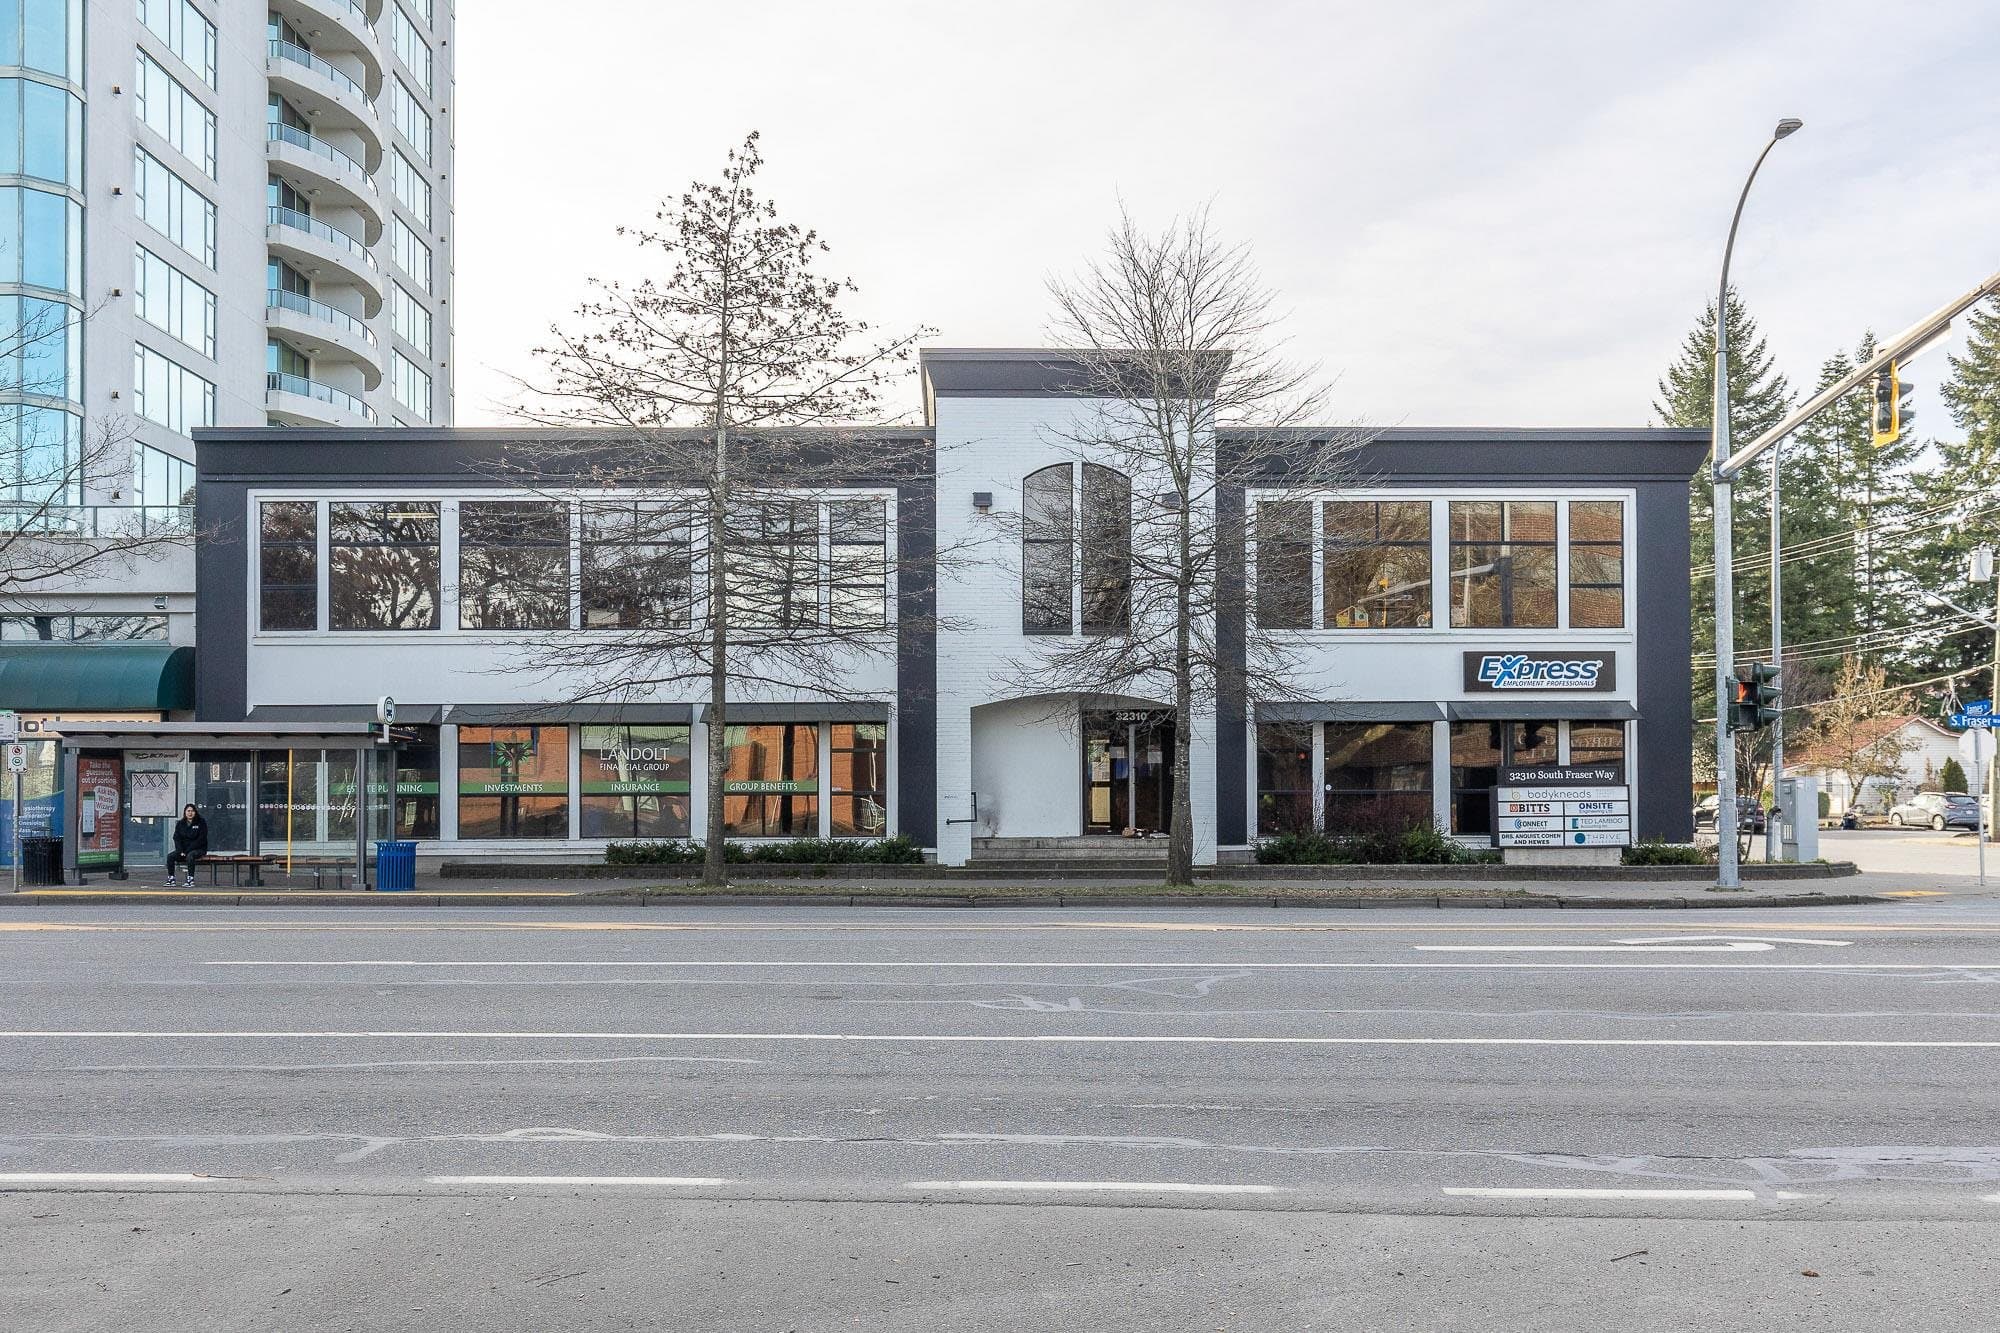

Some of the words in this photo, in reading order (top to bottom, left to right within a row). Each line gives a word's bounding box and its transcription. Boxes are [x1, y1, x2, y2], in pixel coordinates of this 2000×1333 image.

[1115, 712, 1147, 721] 32310
[1951, 715, 1961, 726] S.
[1962, 715, 1992, 727] Fraser
[600, 747, 670, 761] LANDOLT
[643, 763, 670, 771] GROUP
[1509, 772, 1537, 781] 32310
[1537, 770, 1564, 779] South
[1565, 770, 1594, 779] Fraser
[1594, 770, 1615, 780] Way
[484, 783, 543, 792] INVESTMENTS
[611, 783, 660, 792] INSURANCE
[729, 782, 758, 791] GROUP
[760, 782, 798, 791] BENEFITS
[1527, 789, 1592, 800] bodykneads
[1518, 803, 1550, 813] BITTS
[1578, 802, 1613, 810] ONSITE
